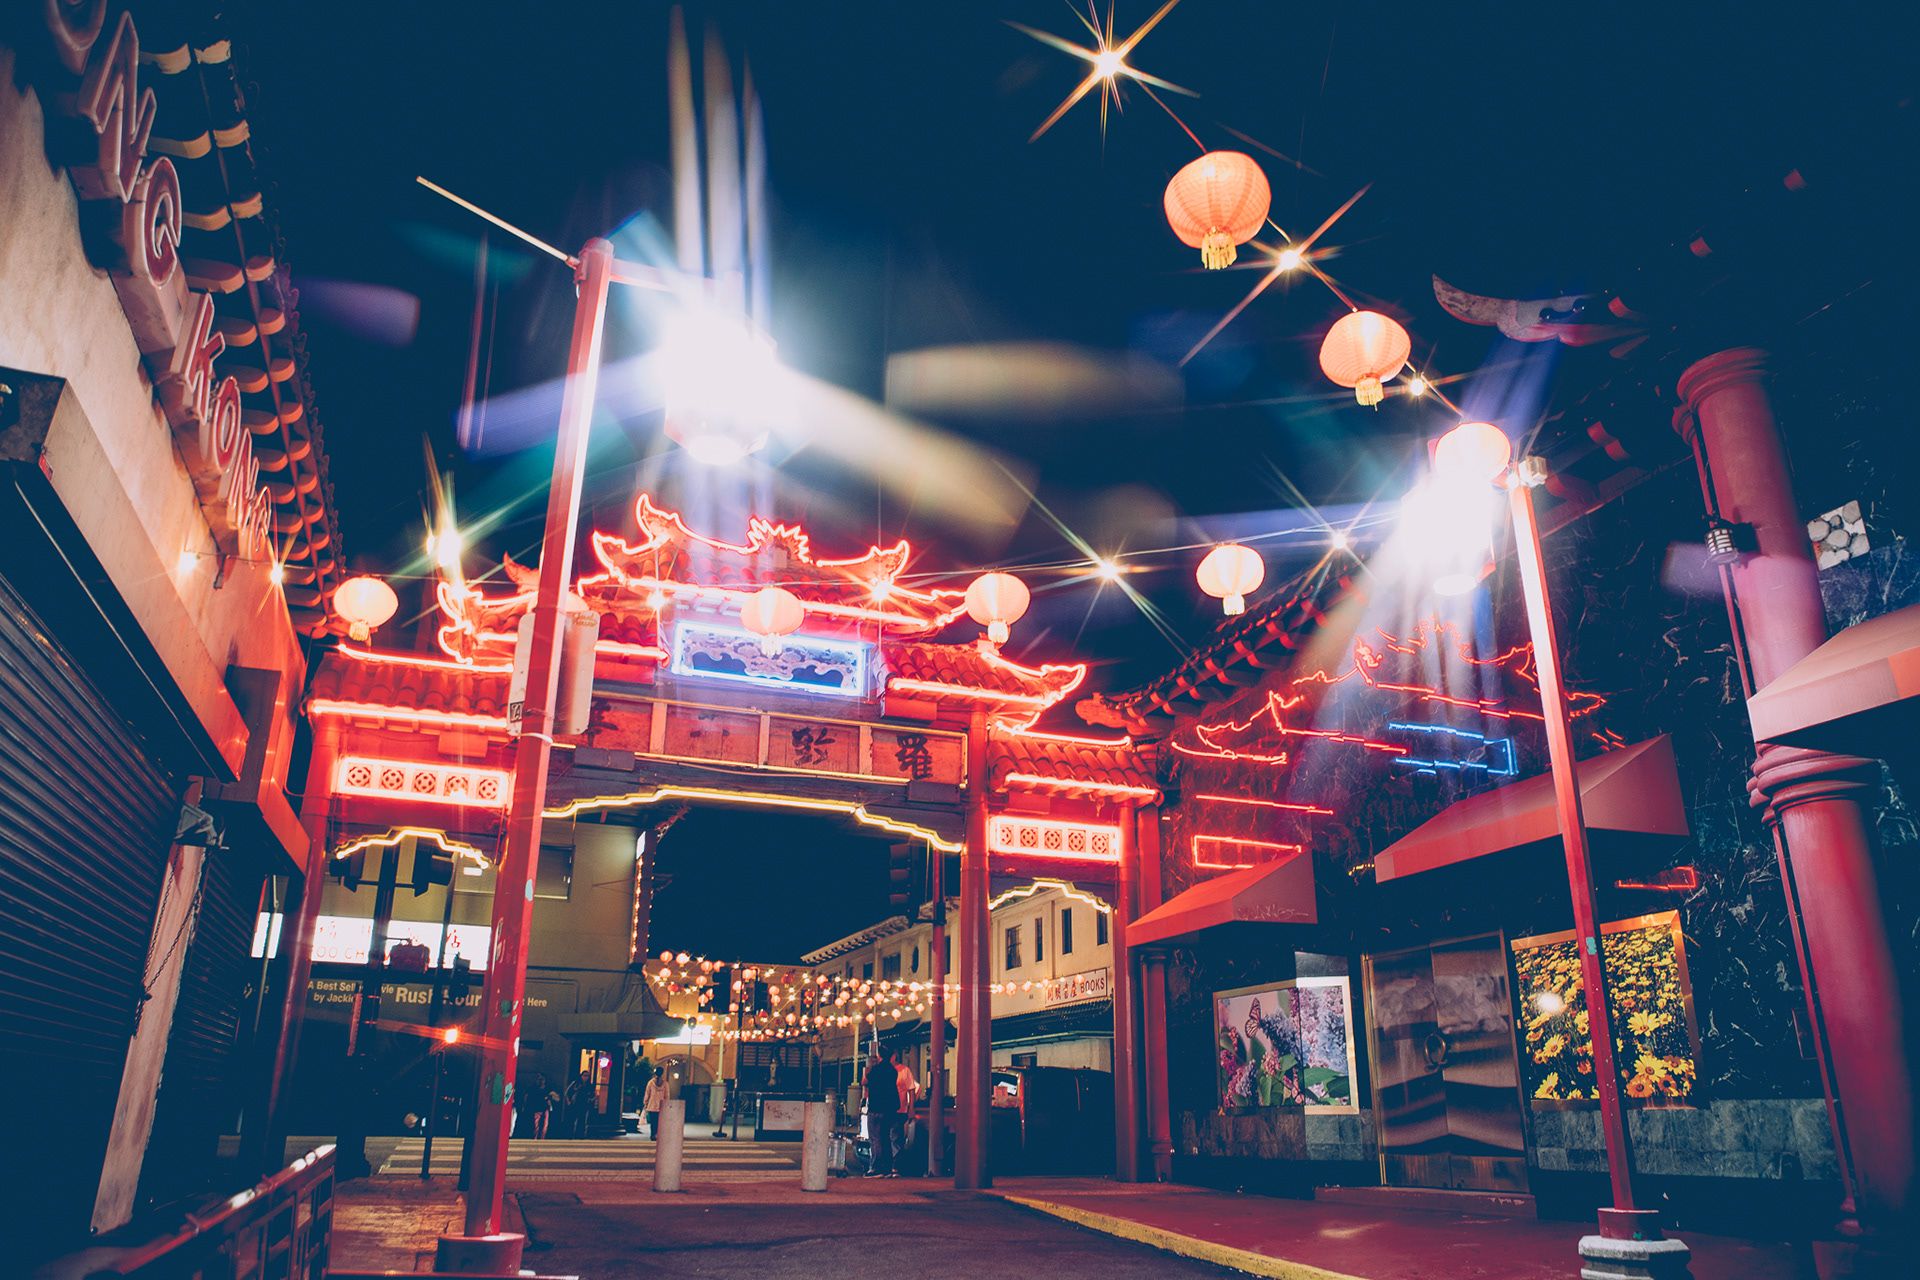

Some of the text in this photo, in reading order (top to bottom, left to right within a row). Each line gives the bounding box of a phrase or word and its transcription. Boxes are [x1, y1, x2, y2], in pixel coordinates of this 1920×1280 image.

[178, 292, 271, 569] KONG
[312, 945, 338, 959] OO
[1081, 977, 1104, 993] BOOKS
[308, 980, 314, 989] A
[317, 981, 337, 990] Best
[527, 997, 547, 1007] Here
[313, 992, 325, 1004] by
